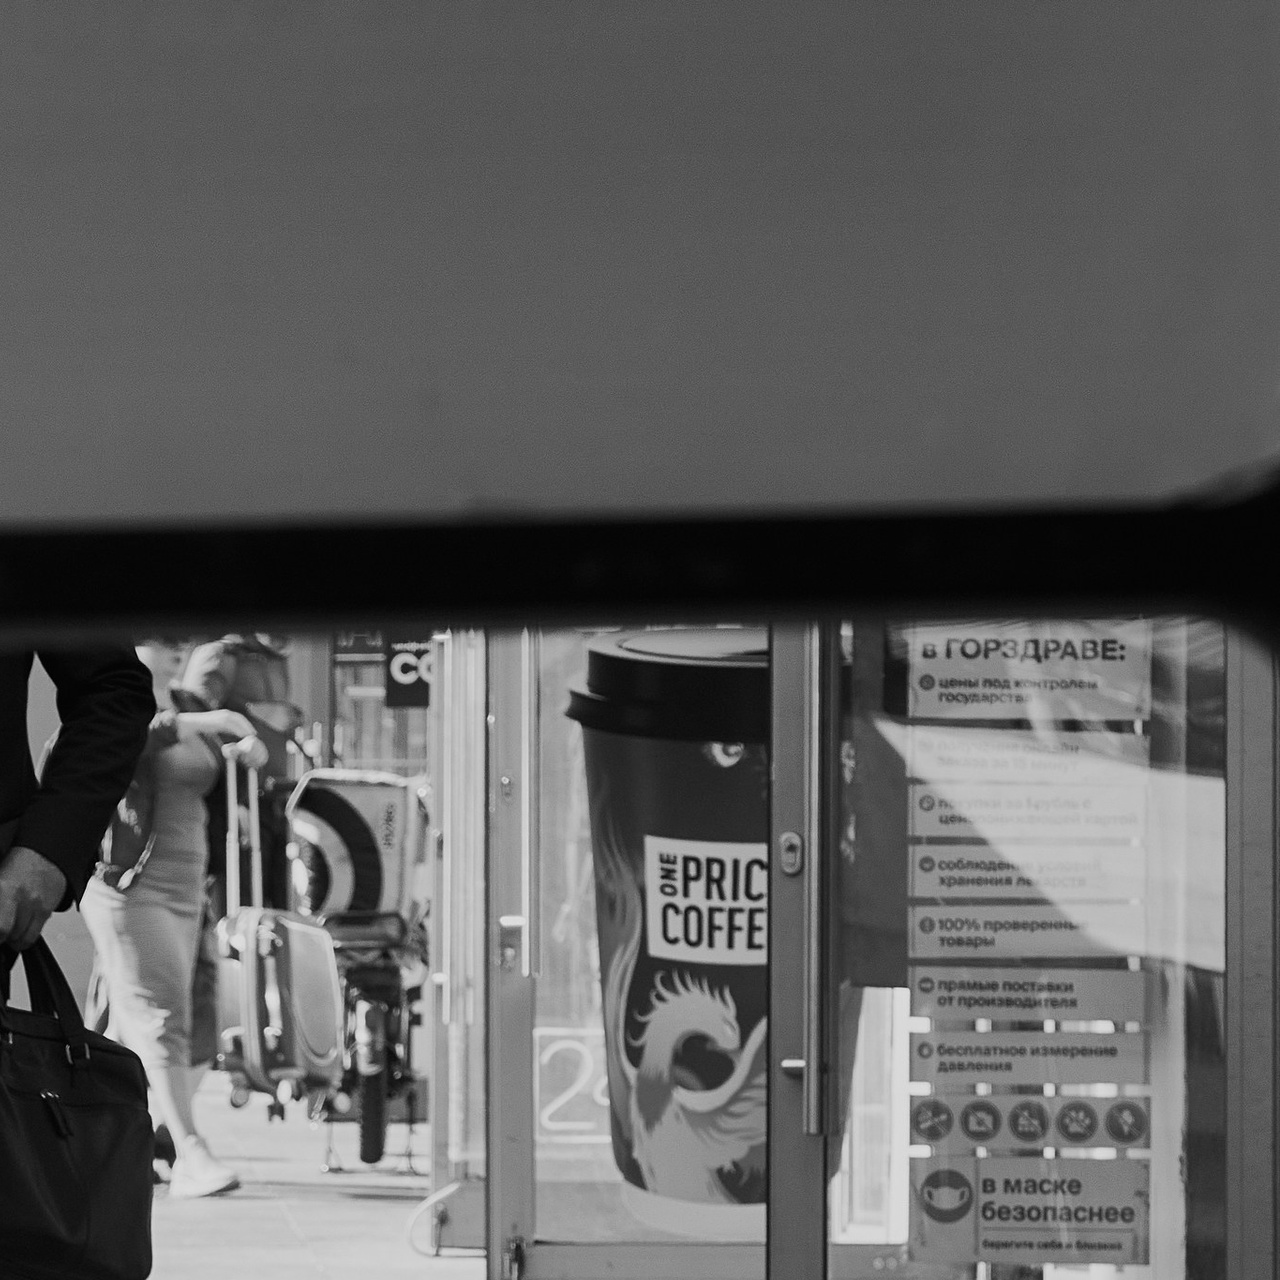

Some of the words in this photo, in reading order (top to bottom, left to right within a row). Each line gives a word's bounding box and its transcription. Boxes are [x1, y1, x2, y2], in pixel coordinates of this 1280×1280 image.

[922, 643, 937, 660] в
[945, 638, 1126, 663] ГОРЗДРАВЕ:
[938, 678, 980, 690] цены
[982, 678, 1011, 691] под
[660, 853, 678, 897] ONE
[682, 855, 768, 901] PRIC
[938, 876, 1013, 888] хранения
[662, 902, 767, 951] COFFE
[938, 918, 981, 931] 100%
[938, 936, 995, 949] товары
[937, 980, 999, 993] прямые
[1002, 980, 1074, 993] поставки
[937, 996, 953, 1007] от
[957, 996, 1078, 1009] производителя
[937, 1043, 1027, 1056] бесплатное
[1030, 1045, 1118, 1058] измерение
[937, 1061, 1012, 1073] давления
[982, 1178, 996, 1195] в
[1003, 1178, 1082, 1195] маске
[981, 1201, 1135, 1223] безопаснее
